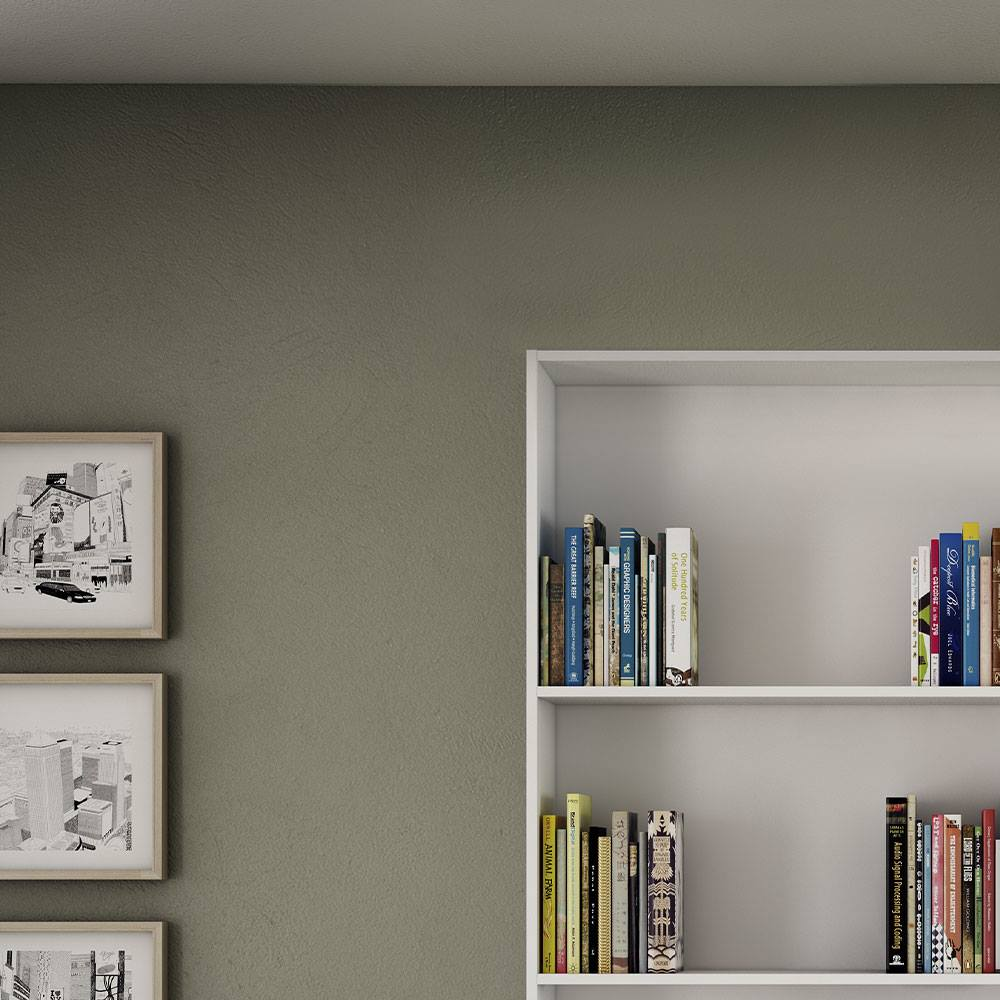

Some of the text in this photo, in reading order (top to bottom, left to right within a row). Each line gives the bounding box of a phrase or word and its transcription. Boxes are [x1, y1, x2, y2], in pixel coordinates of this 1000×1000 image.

[680, 552, 688, 622] One Hundred Years
[940, 548, 959, 616] Deepest Blue
[545, 844, 553, 875] ANIMAL
[964, 838, 972, 852] LORD
[545, 878, 553, 900] FARM
[964, 866, 972, 882] FLIES
[893, 842, 902, 949] Audio Signal Processing and Coding
